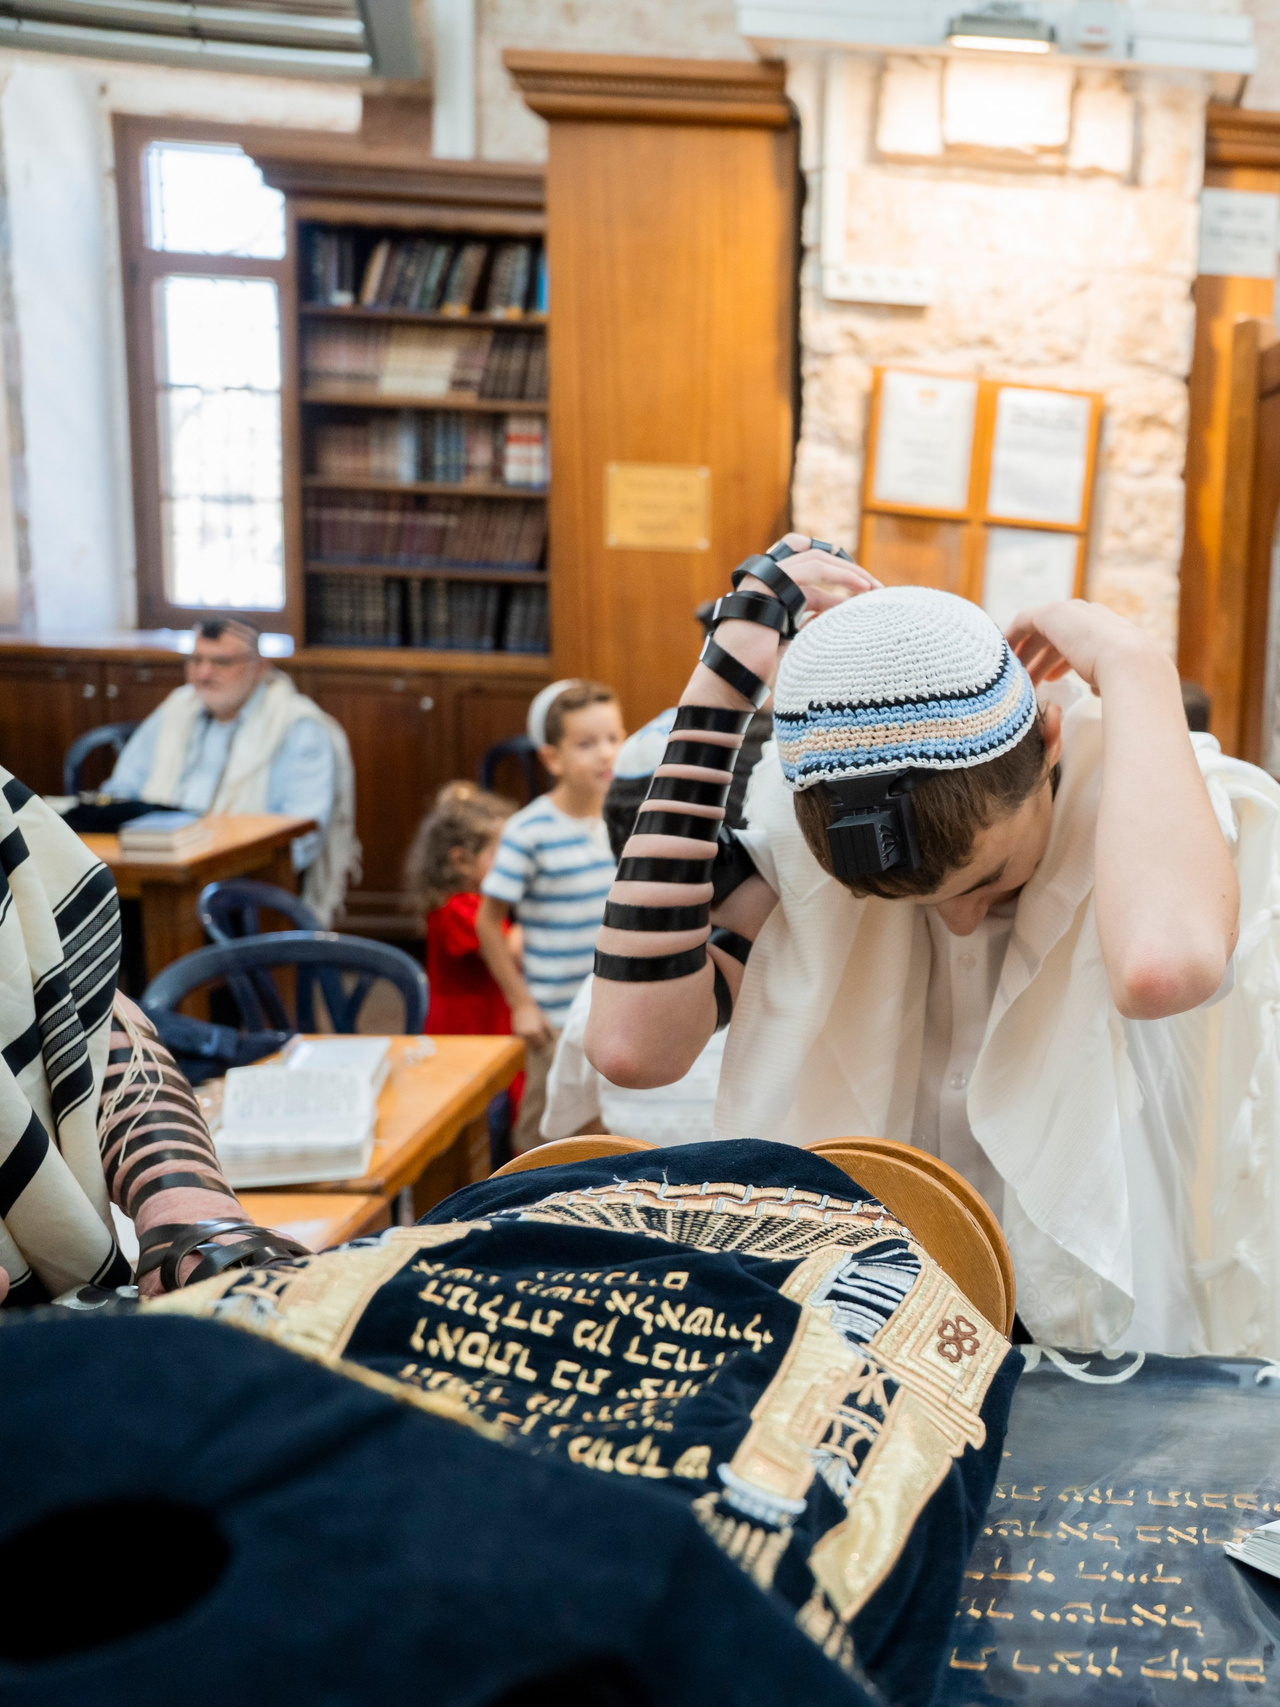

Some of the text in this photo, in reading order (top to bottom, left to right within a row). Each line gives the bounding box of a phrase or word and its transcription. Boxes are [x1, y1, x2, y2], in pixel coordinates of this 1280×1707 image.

[418, 1279, 564, 1337] הנולדת
[573, 1314, 621, 1357] מן
[410, 1317, 538, 1382] ואסתר
[551, 1359, 612, 1395] בת
[568, 1434, 712, 1480] מוקדש
[984, 1520, 1120, 1550] שראל
[1030, 1602, 1205, 1638] ישראל
[1012, 1646, 1123, 1678] רצון
[1140, 1648, 1267, 1685] קונם
